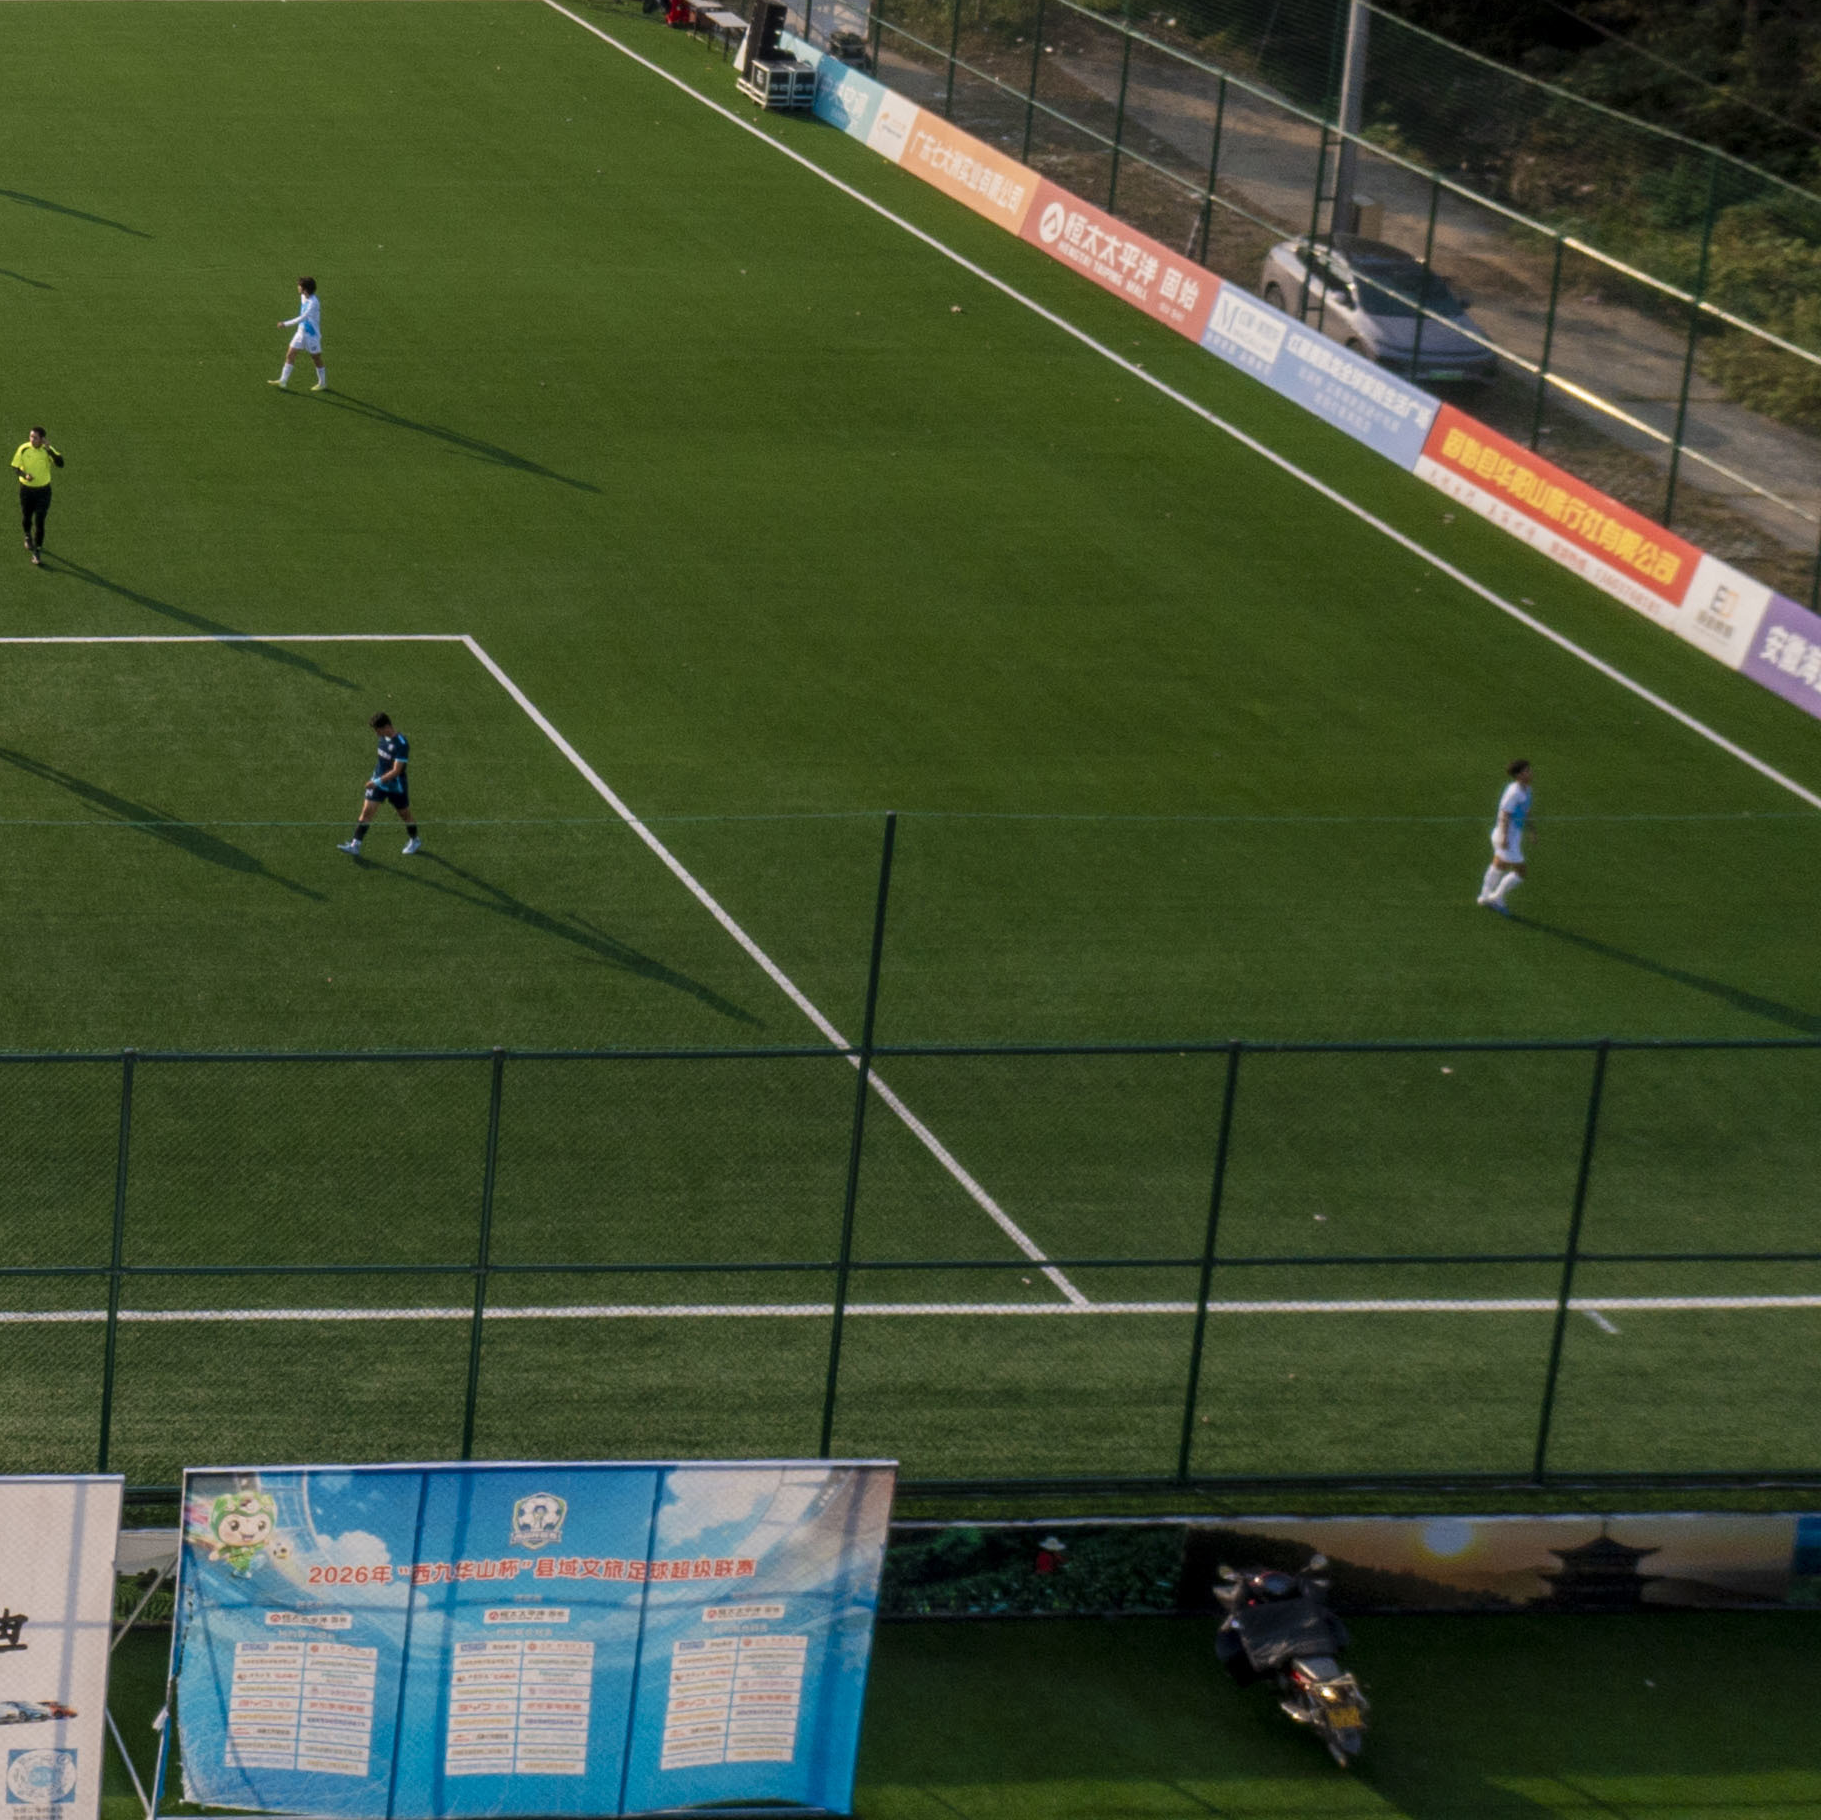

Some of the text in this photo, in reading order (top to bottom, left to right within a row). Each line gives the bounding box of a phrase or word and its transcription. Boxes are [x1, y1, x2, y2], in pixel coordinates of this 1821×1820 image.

[1063, 210, 1200, 313] 恒太太平洋 固始
